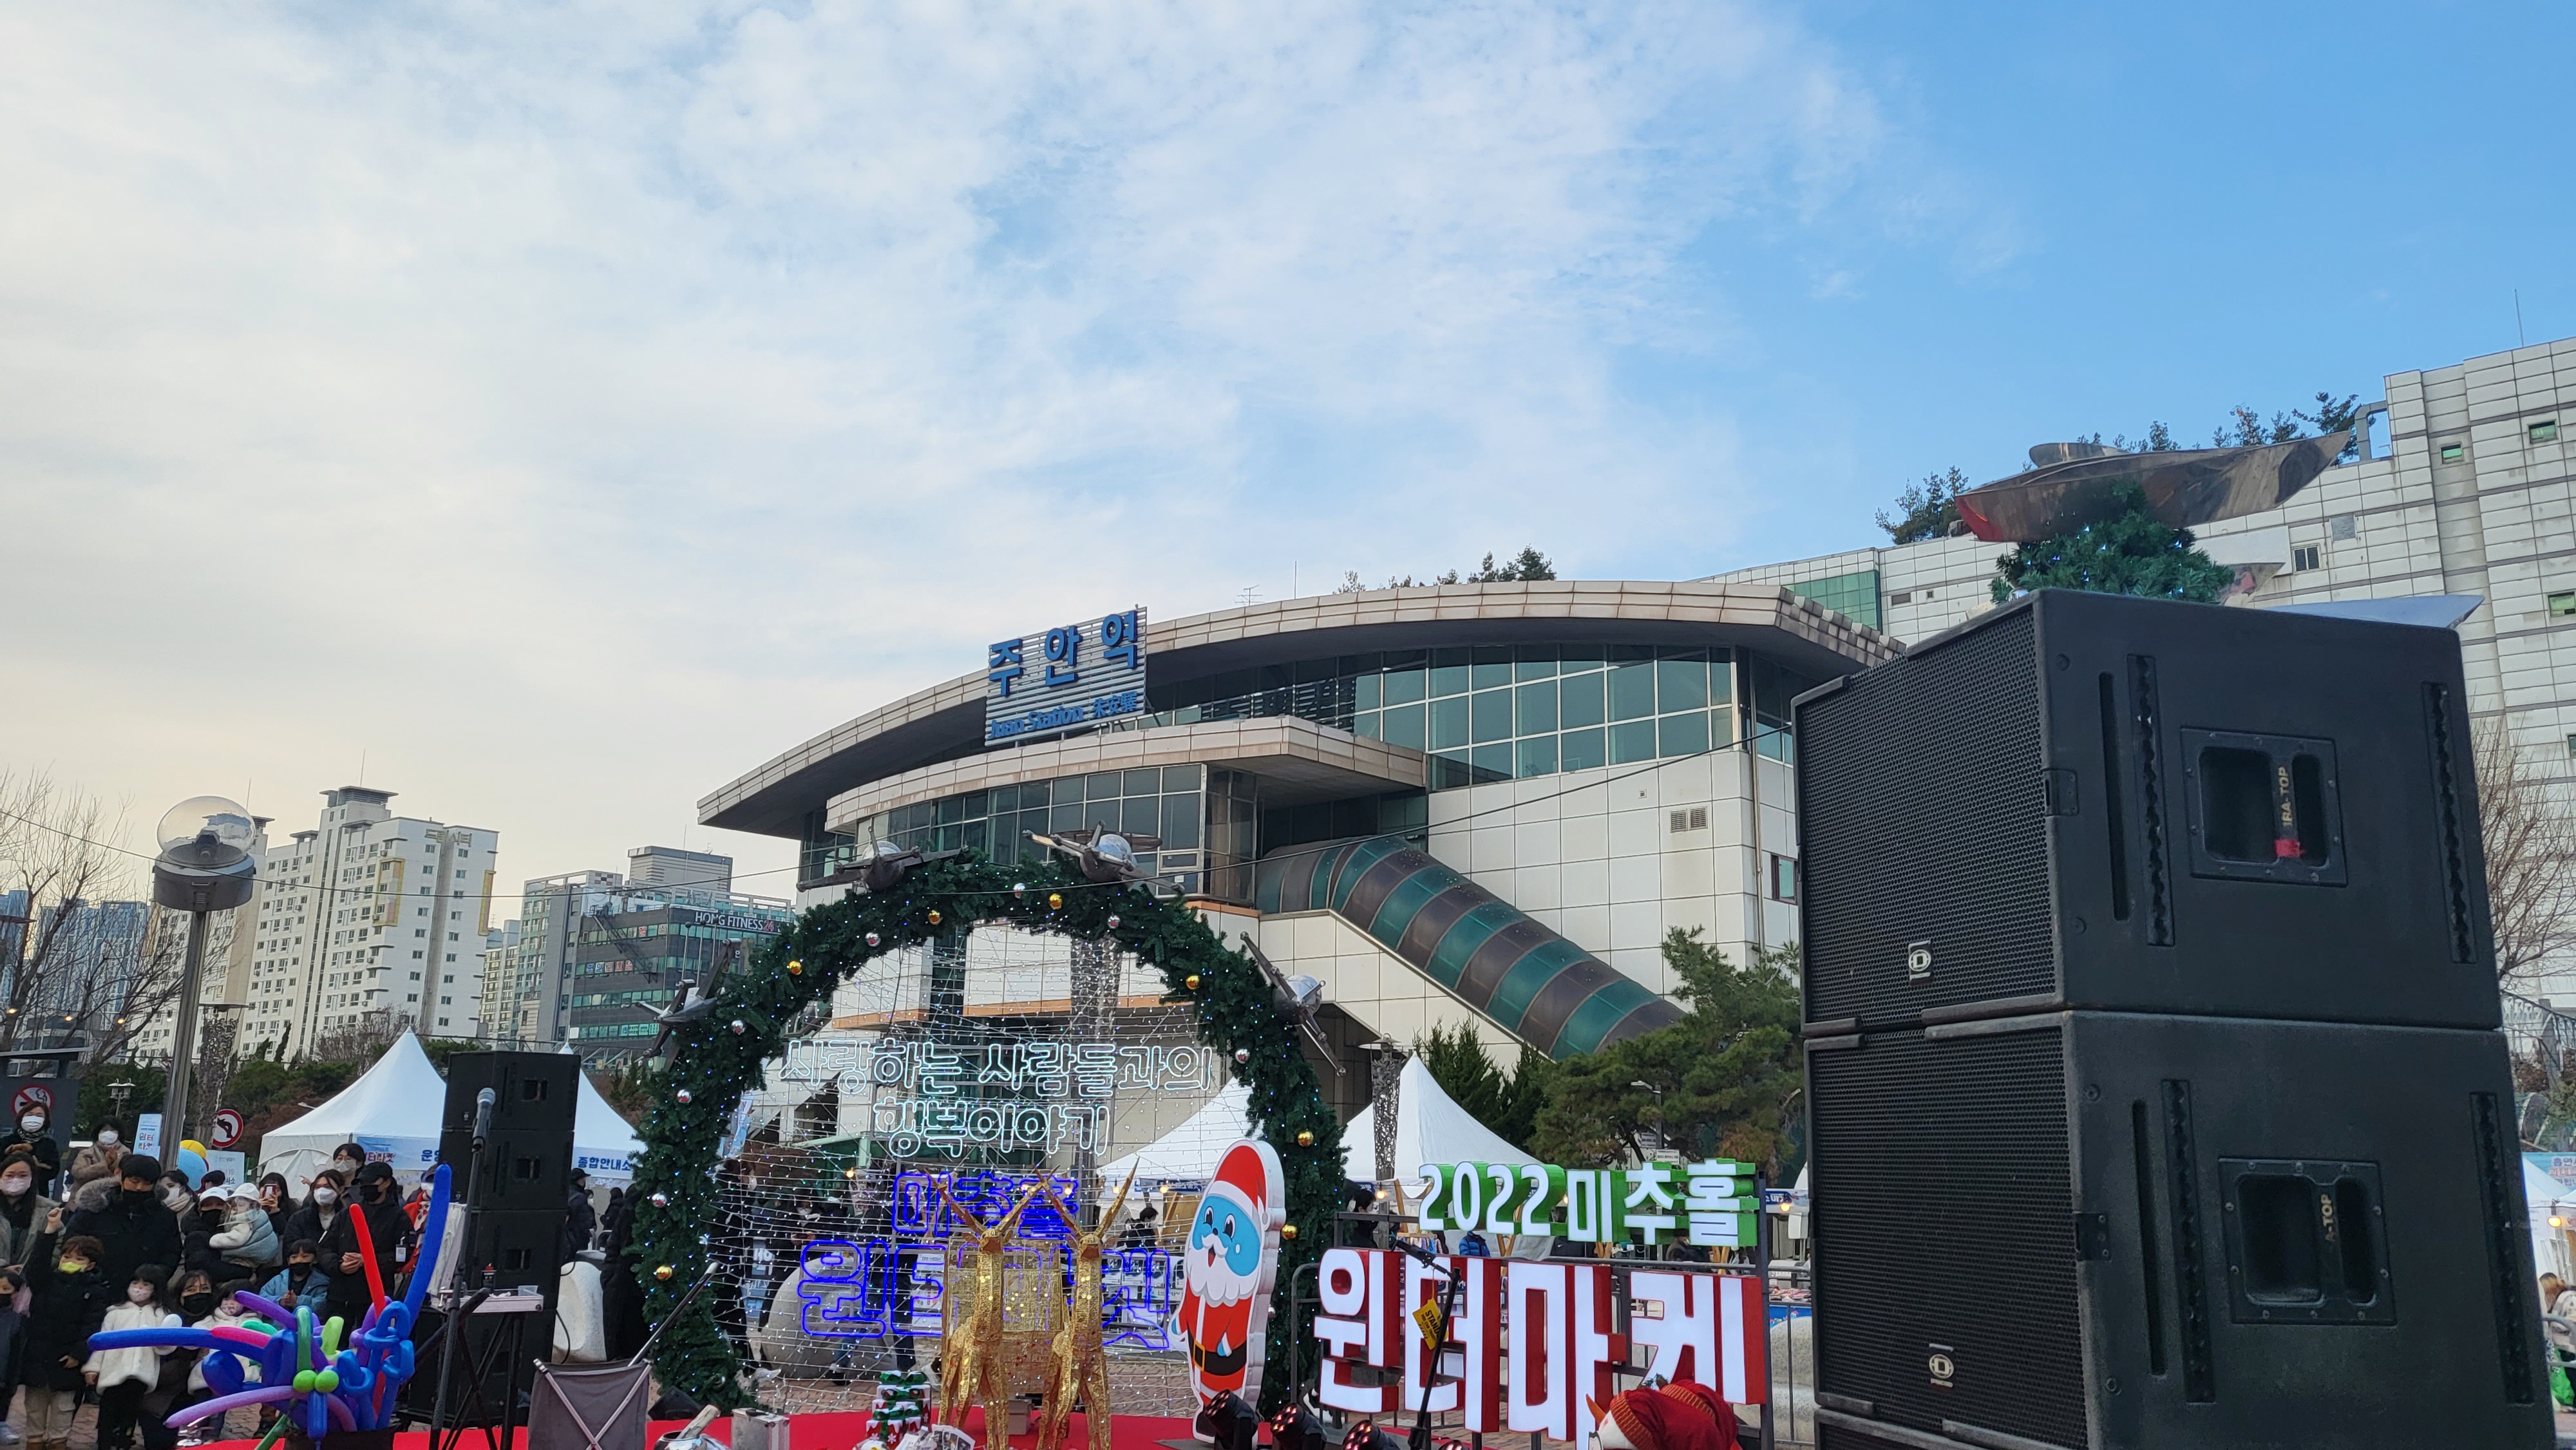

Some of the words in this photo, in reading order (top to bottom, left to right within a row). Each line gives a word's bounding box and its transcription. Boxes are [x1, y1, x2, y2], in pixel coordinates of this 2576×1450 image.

[989, 610, 1138, 697] 주안역
[989, 717, 1025, 739] Juan
[1028, 706, 1084, 731] Station
[696, 911, 725, 926] HONG
[779, 1038, 963, 1094] 사랑하는
[978, 1042, 1212, 1097] 사람들과의
[873, 1097, 1110, 1157] 행복이야기
[578, 1156, 631, 1171] 종합안내소
[1419, 1161, 1552, 1236] 2022
[1567, 1159, 1741, 1248] 미추홀
